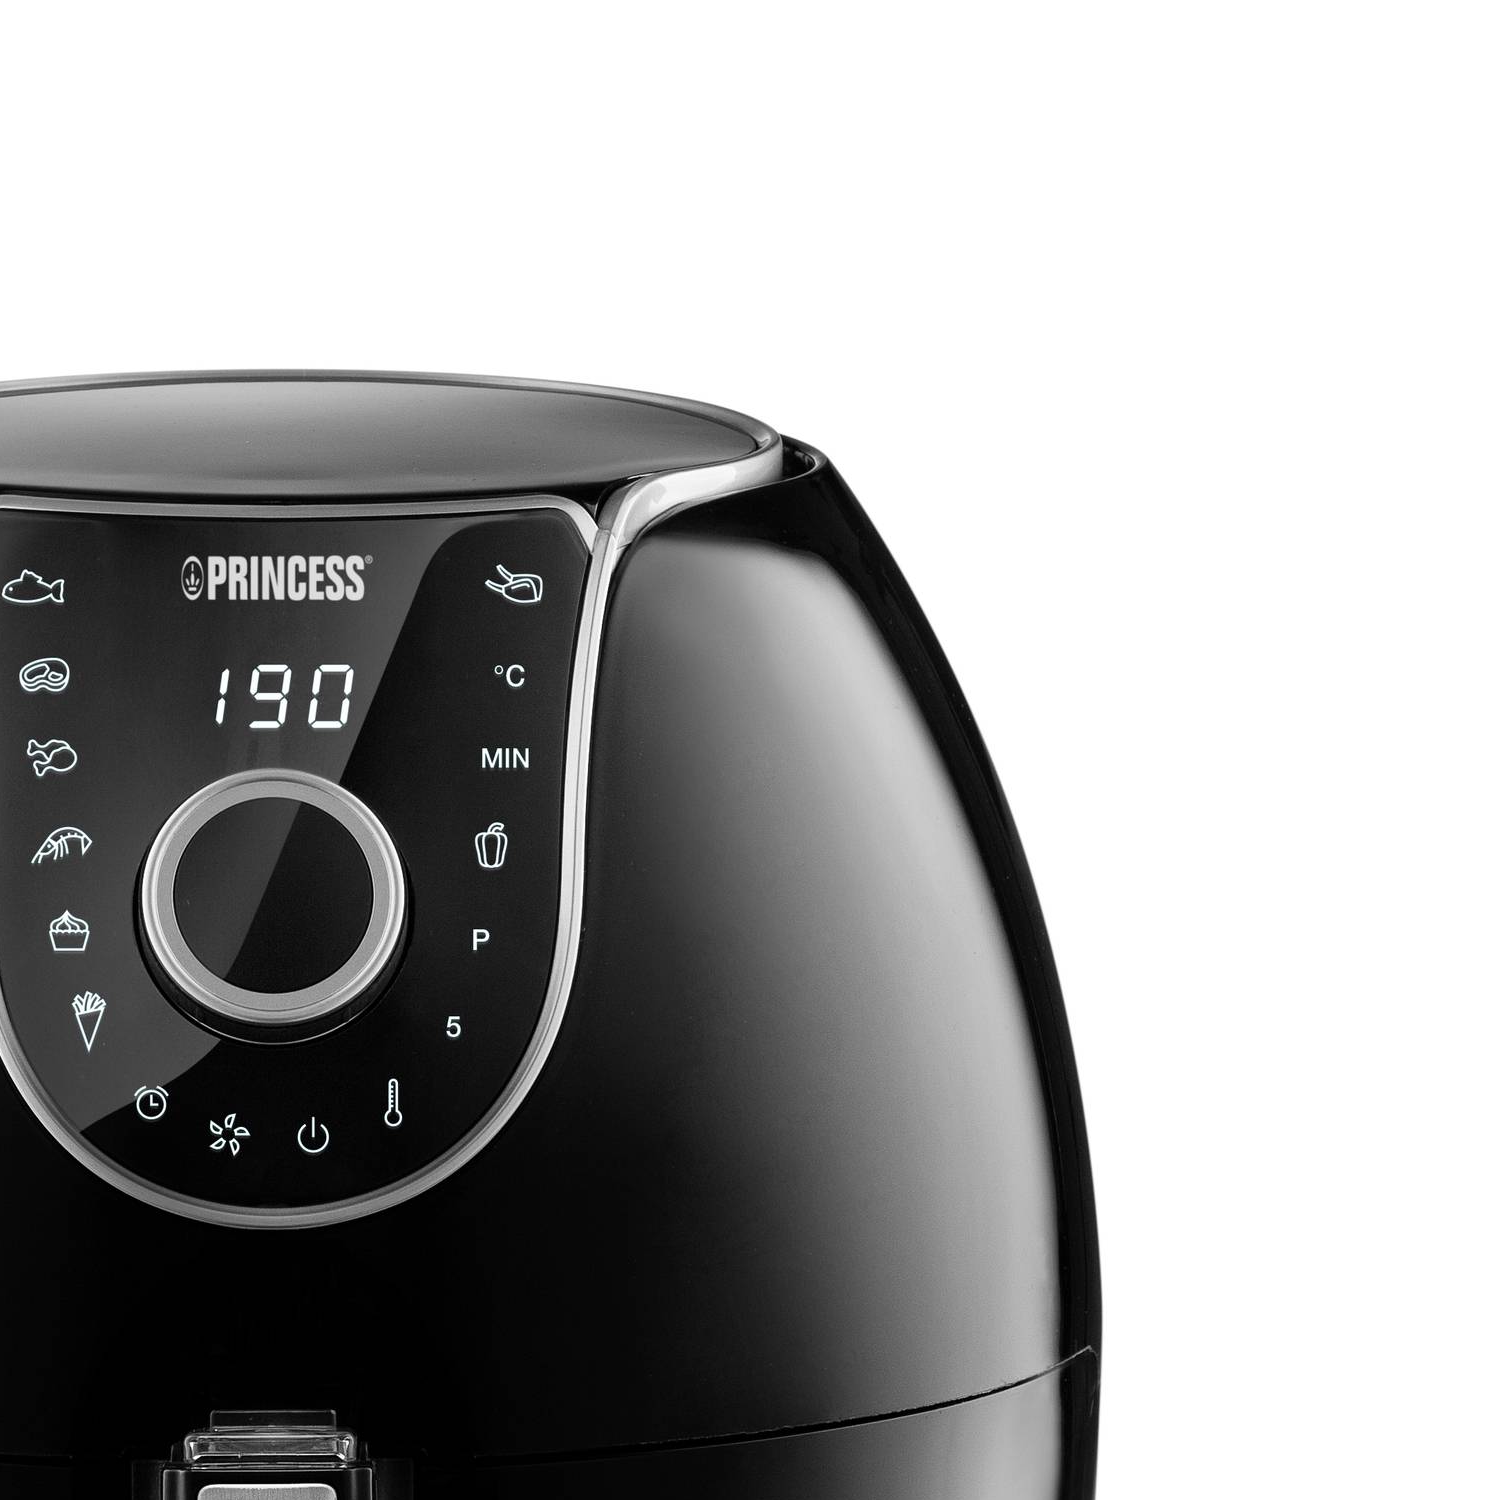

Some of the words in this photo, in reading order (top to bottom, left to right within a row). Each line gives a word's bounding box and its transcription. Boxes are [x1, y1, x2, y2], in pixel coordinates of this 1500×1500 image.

[494, 664, 525, 688] °C
[215, 664, 355, 729] 190
[481, 747, 530, 769] MIN
[472, 928, 490, 951] P
[446, 1015, 462, 1038] 5
